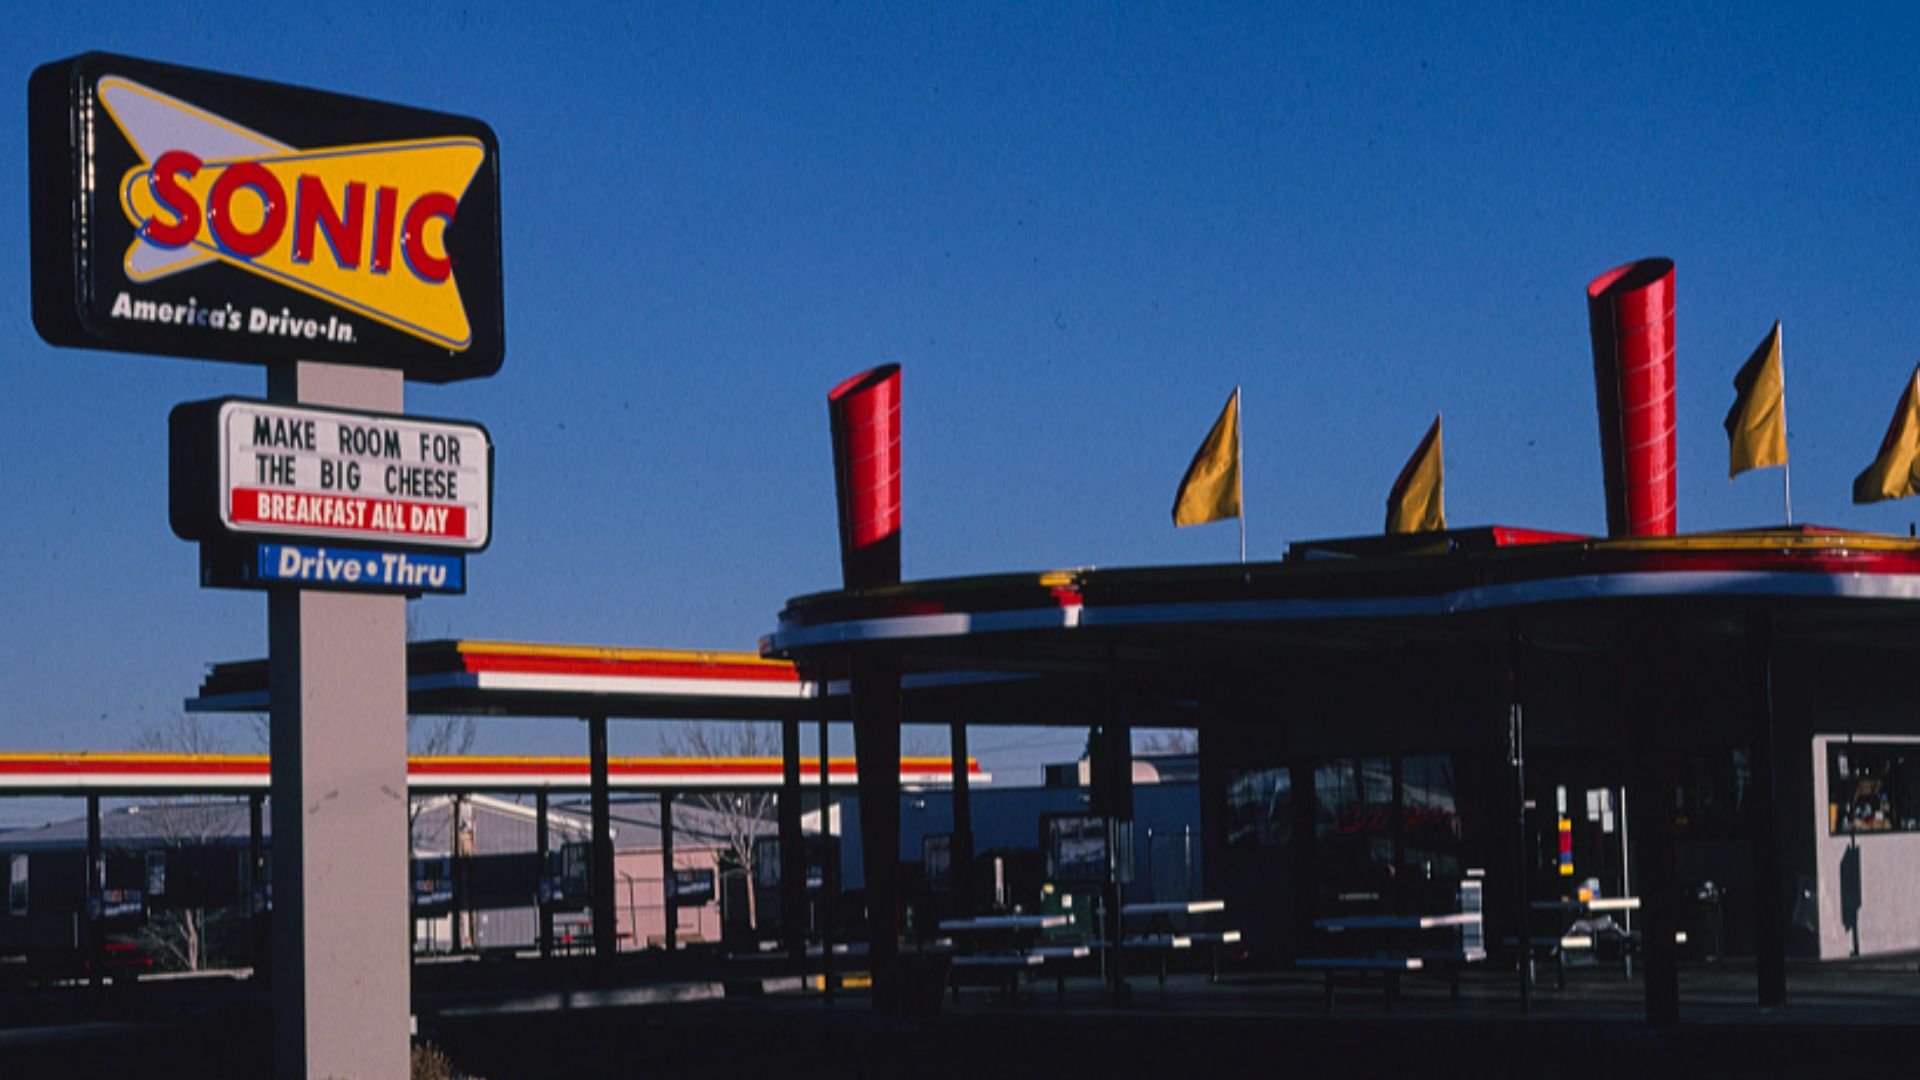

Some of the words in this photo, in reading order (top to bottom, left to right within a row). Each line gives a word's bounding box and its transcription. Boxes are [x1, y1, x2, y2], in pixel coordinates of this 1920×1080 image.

[140, 150, 459, 284] SONIC
[112, 293, 243, 332] America's
[253, 415, 316, 450] MAKE
[338, 425, 401, 459] ROOM
[419, 432, 461, 464] FOR
[256, 454, 296, 485] THE
[321, 459, 361, 491] BIG
[385, 466, 457, 500] CHEESE
[257, 493, 367, 527] BREAKFAST
[371, 503, 406, 530] ALL
[410, 507, 449, 533] DAY
